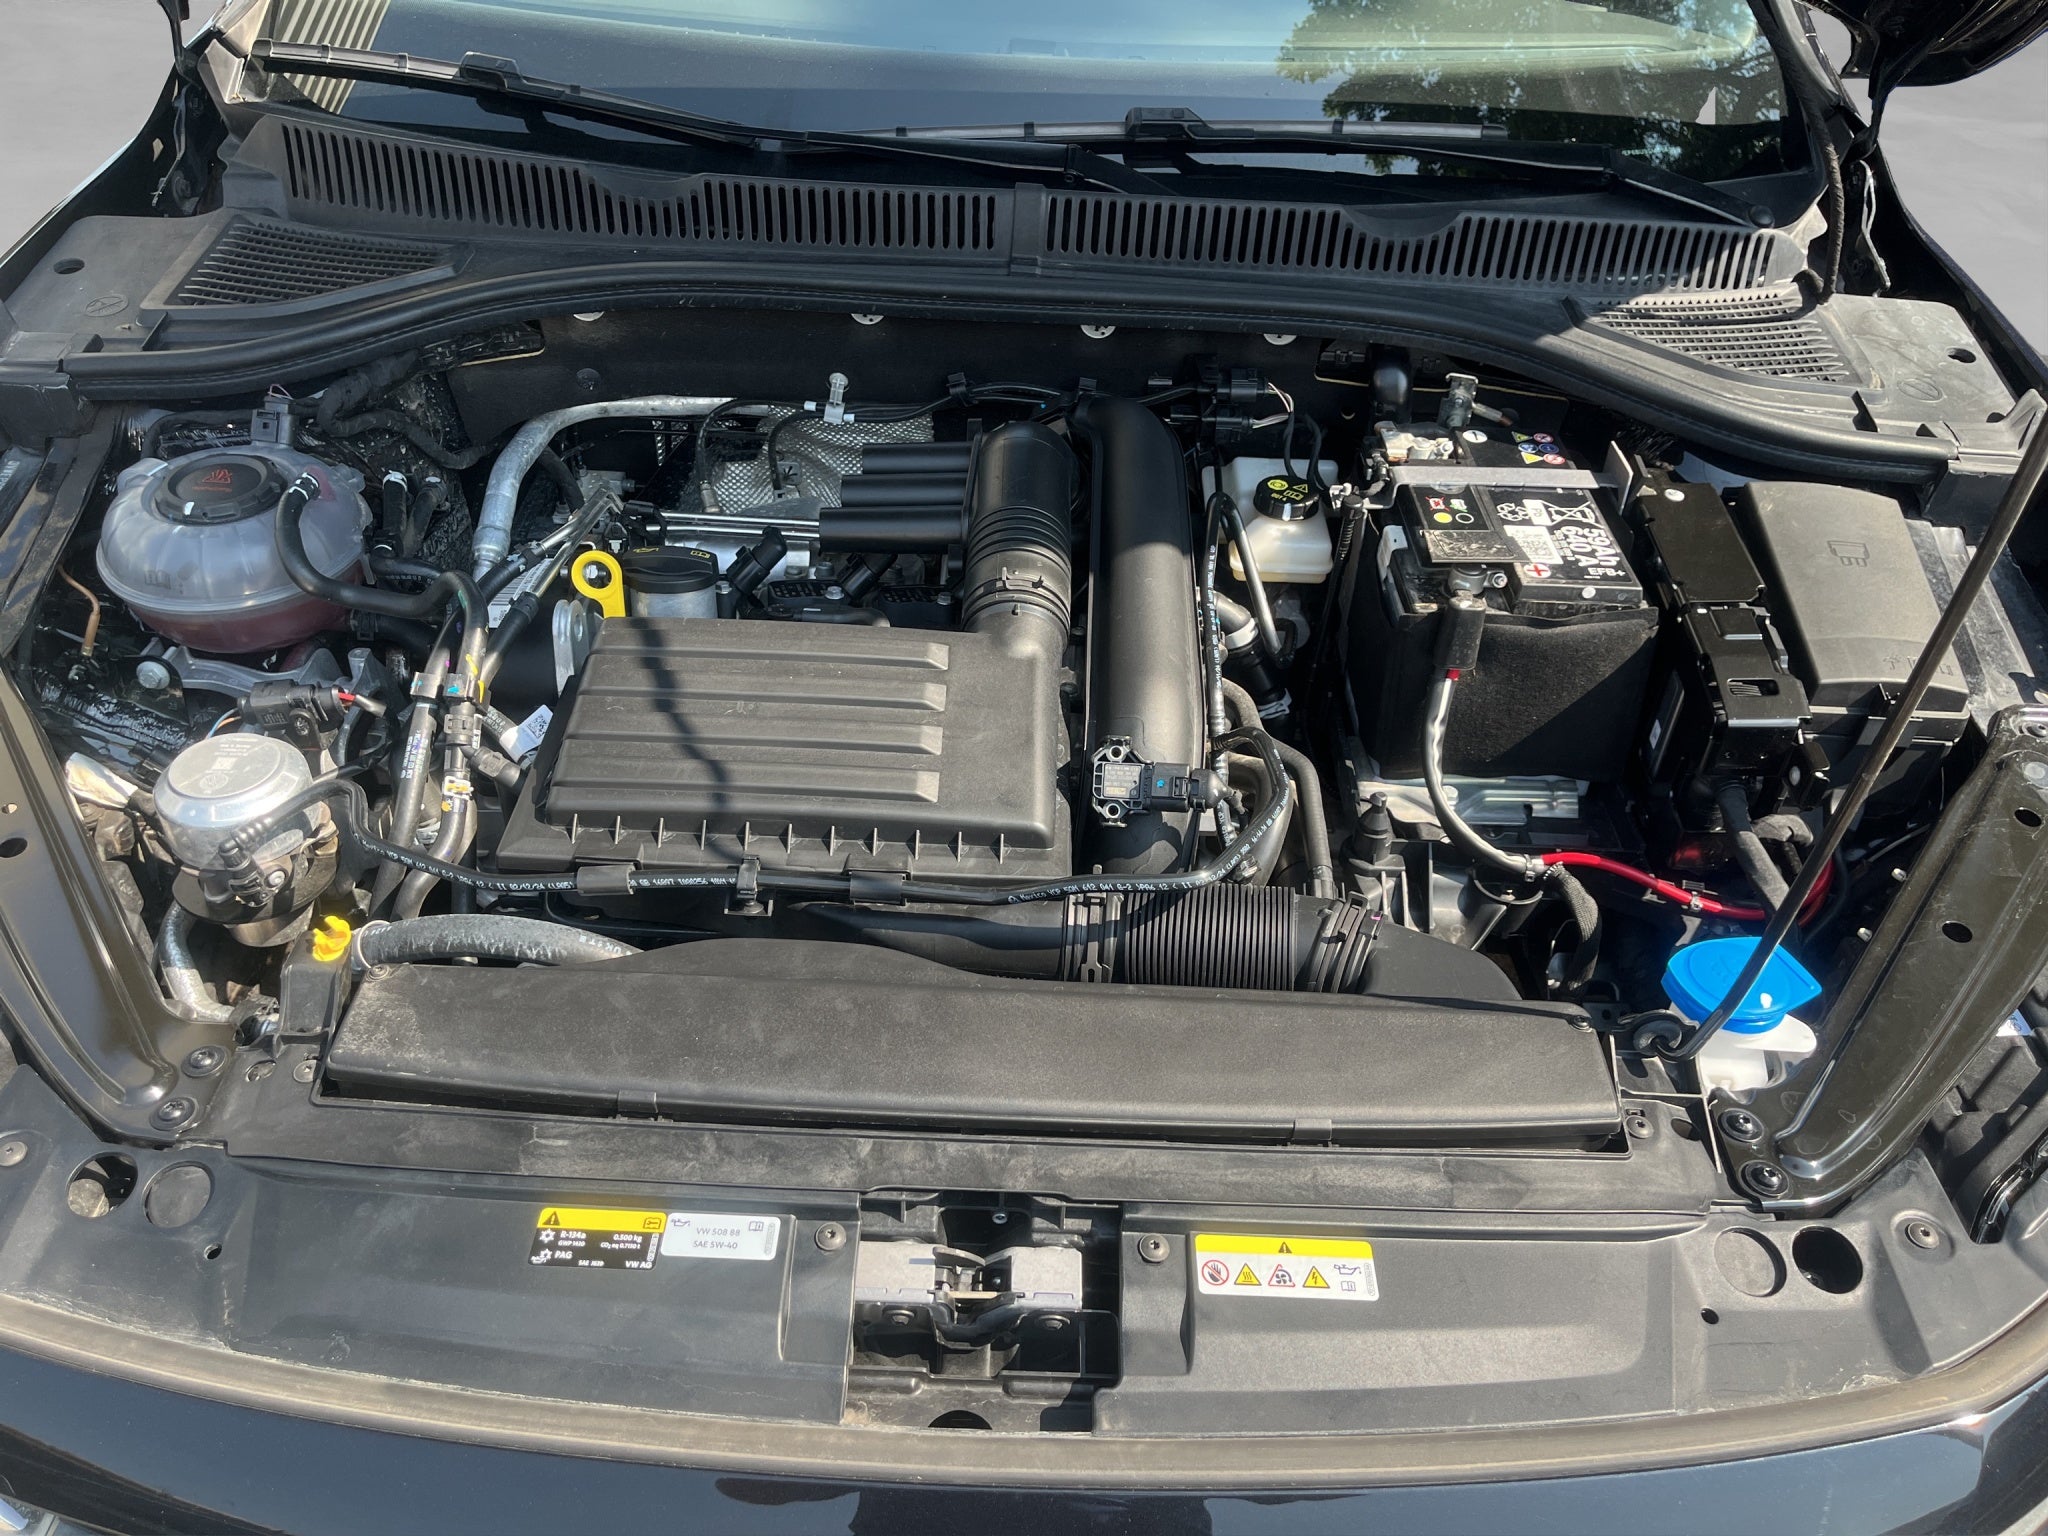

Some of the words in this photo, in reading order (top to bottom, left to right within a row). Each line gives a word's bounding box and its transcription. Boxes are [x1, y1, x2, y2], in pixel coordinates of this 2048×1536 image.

[1561, 526, 1592, 552] 640
[1583, 528, 1620, 567] 59Ah
[1588, 568, 1625, 577] EFB+
[1082, 882, 1097, 891] 612
[559, 1230, 587, 1240] R-134a
[613, 1234, 633, 1242] 0.500
[633, 1235, 642, 1243] kg
[696, 1228, 710, 1236] VW
[693, 1240, 708, 1248] SAE
[710, 1240, 738, 1250] 5W-40
[554, 1250, 573, 1259] PAG
[625, 1260, 640, 1268] VW
